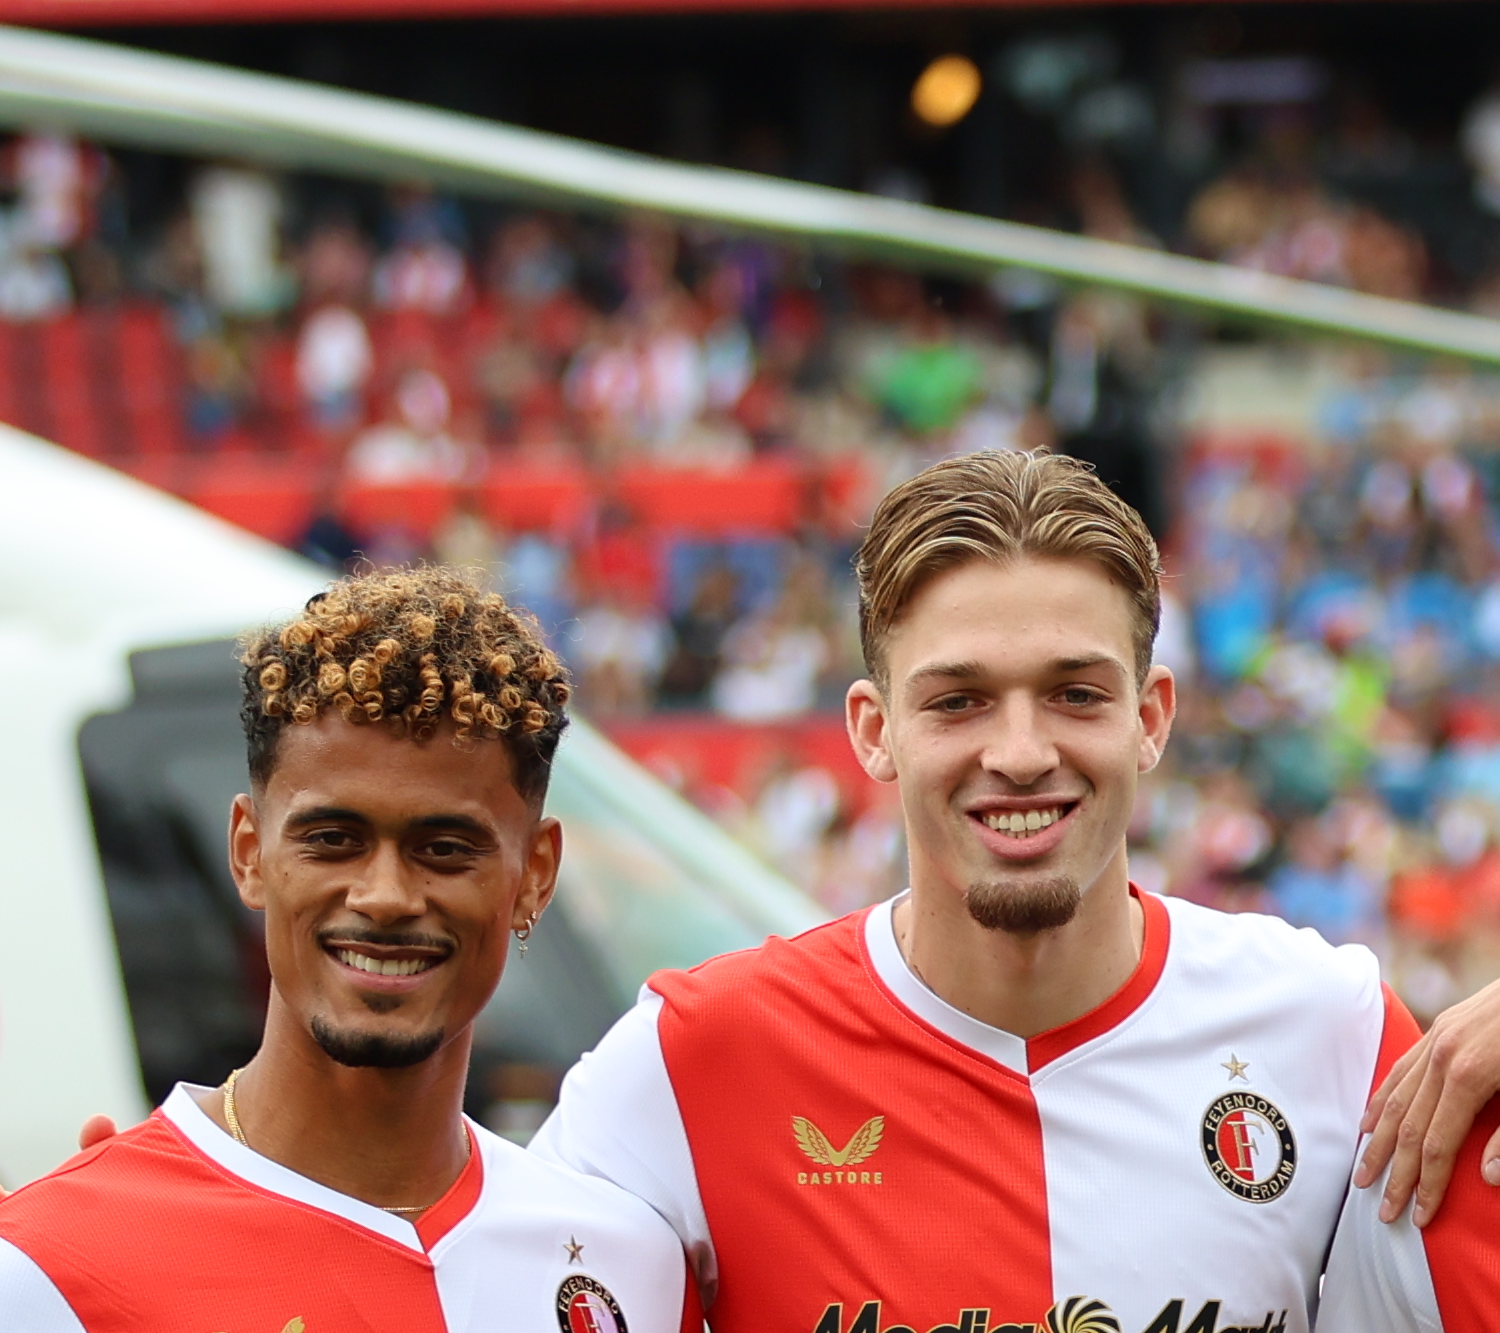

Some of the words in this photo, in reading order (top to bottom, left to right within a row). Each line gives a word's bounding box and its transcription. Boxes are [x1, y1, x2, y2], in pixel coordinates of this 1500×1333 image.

[1205, 1095, 1286, 1132] FEYENOORD
[1227, 1121, 1264, 1171] F
[797, 1172, 883, 1185] CASTORE
[1212, 1160, 1294, 1198] ROTTERDAM
[559, 1278, 619, 1314] FEYENOORD
